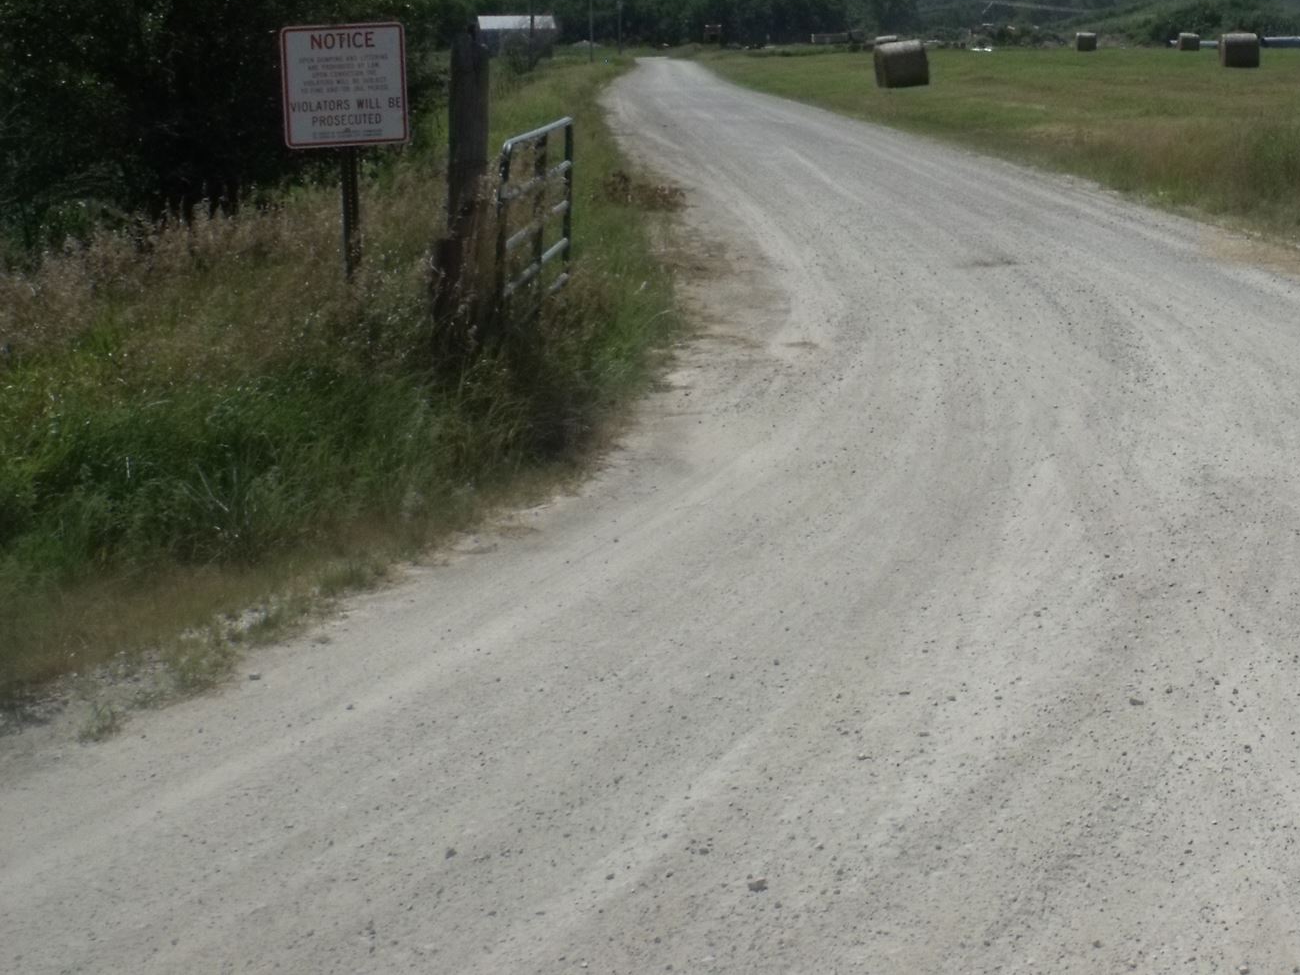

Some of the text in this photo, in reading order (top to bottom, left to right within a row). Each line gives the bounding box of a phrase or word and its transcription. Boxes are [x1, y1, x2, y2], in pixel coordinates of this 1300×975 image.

[310, 31, 376, 50] NOTICE
[290, 97, 401, 113] VIOLATORS WILL BE
[312, 112, 382, 126] PROSECUTED
